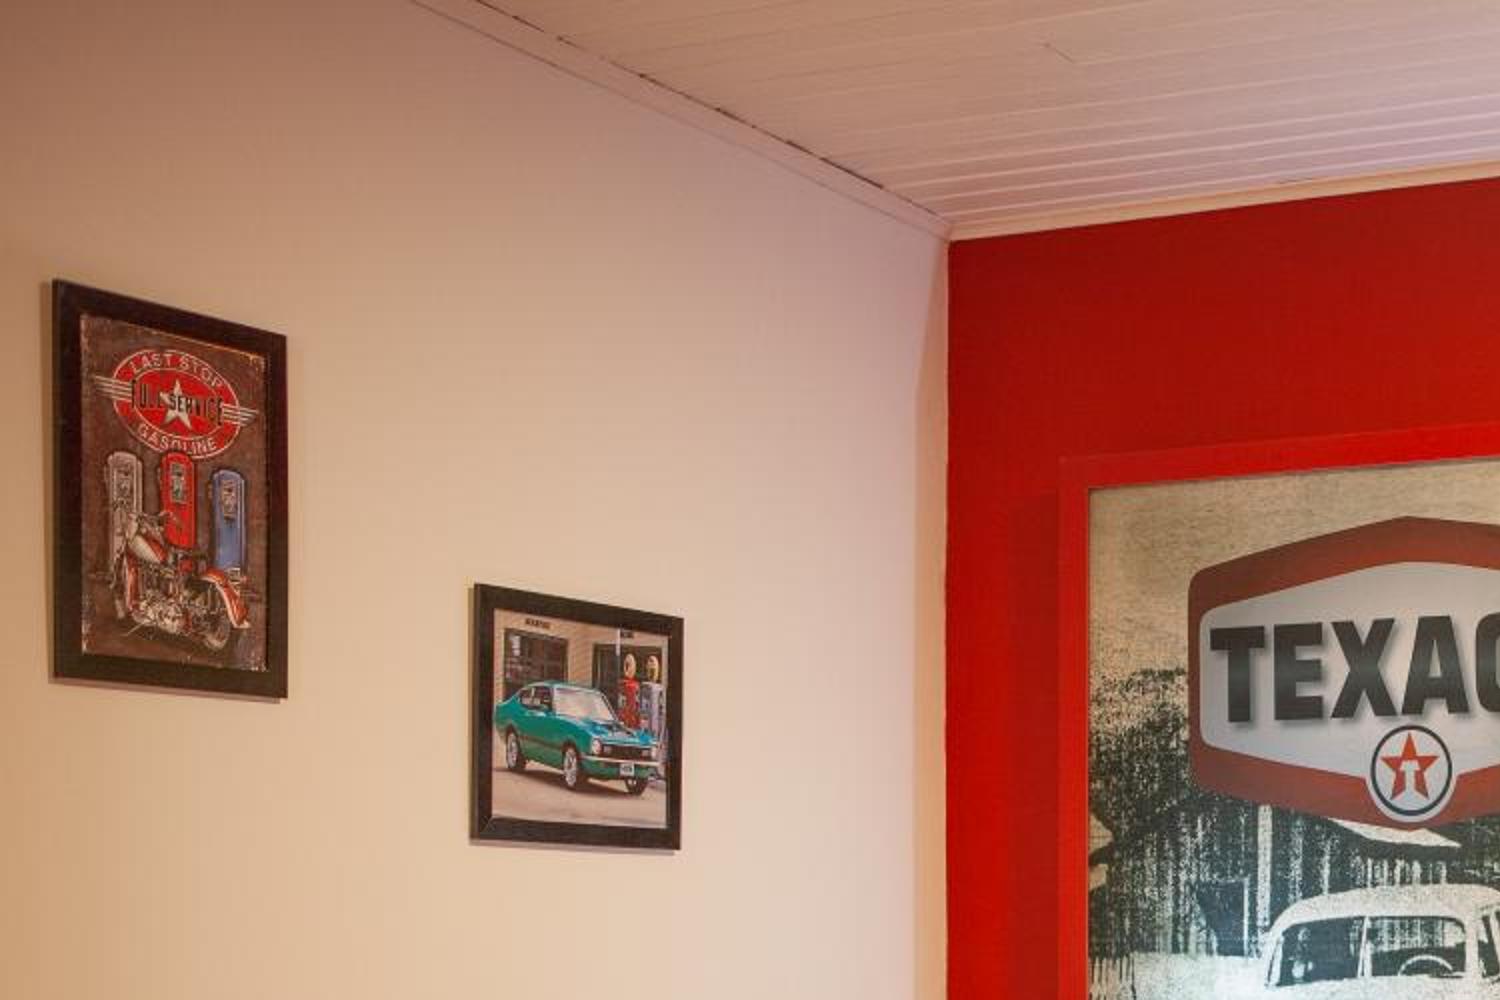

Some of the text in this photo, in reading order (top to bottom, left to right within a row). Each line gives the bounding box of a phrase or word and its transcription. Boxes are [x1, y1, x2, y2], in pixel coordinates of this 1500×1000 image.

[129, 353, 223, 387] LAST STOP
[137, 424, 218, 454] GASOLINE
